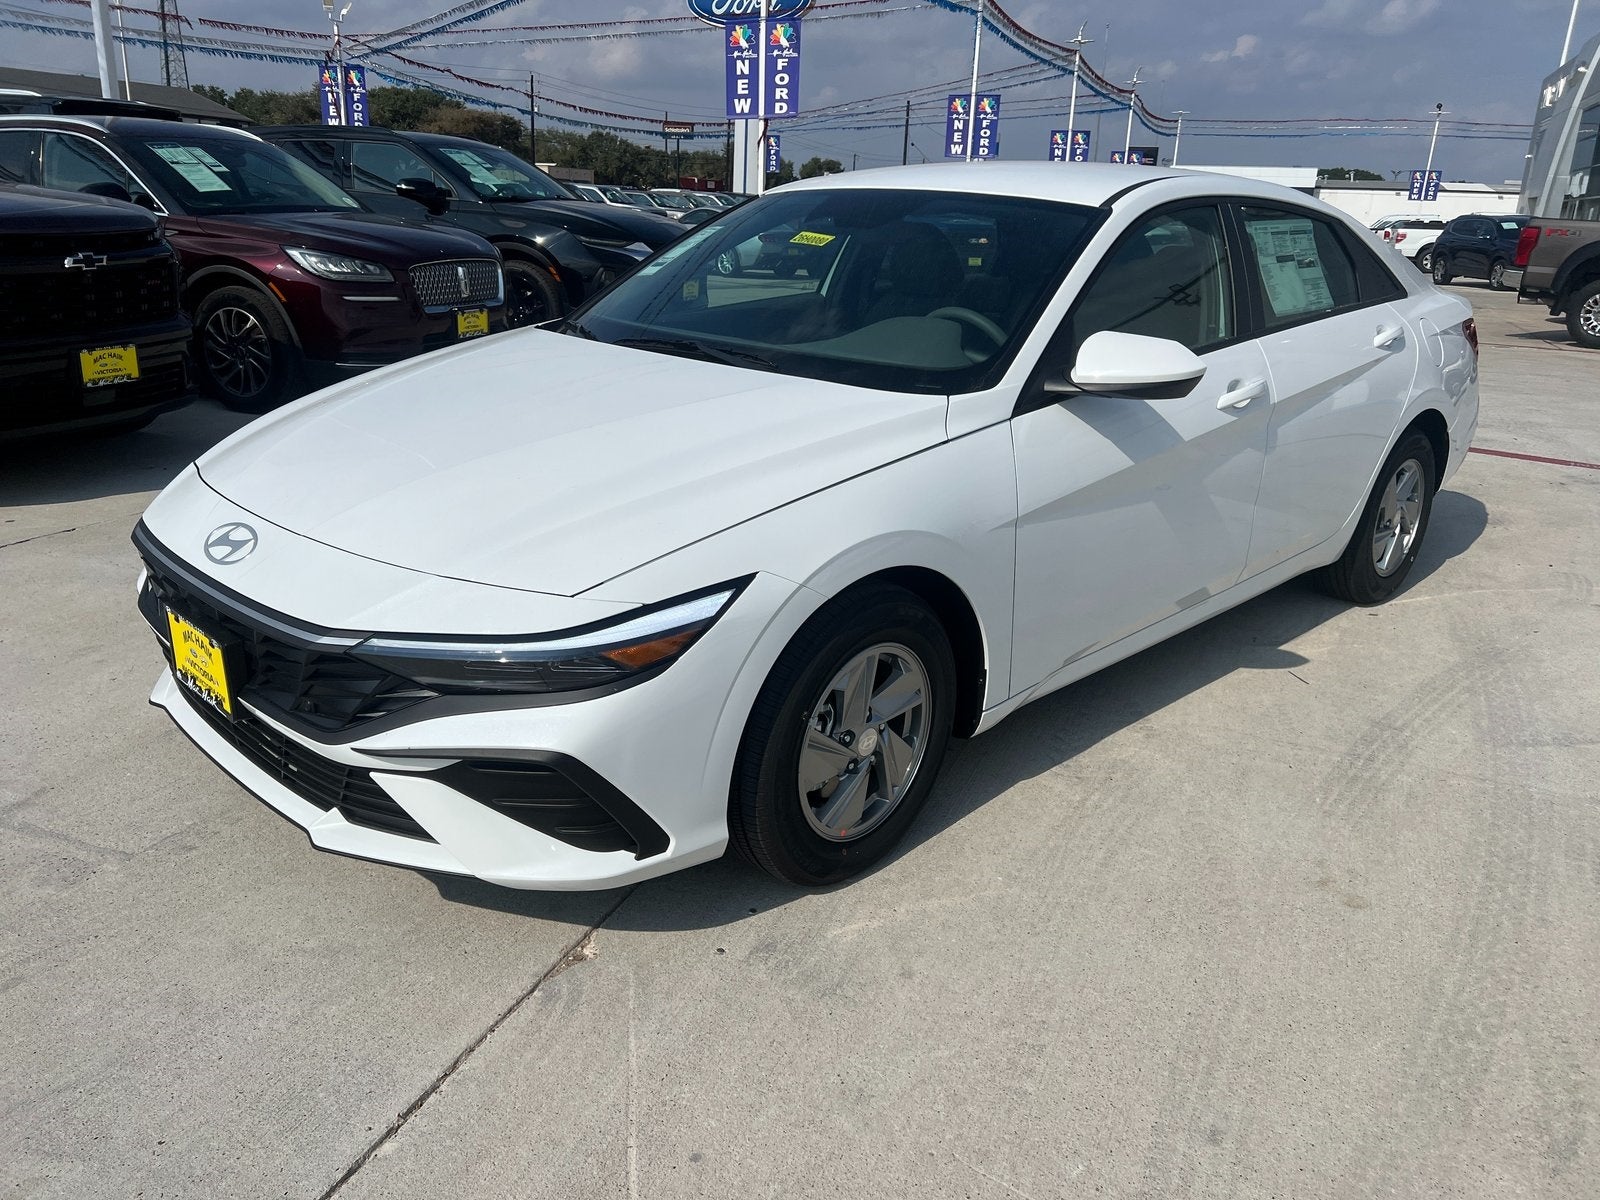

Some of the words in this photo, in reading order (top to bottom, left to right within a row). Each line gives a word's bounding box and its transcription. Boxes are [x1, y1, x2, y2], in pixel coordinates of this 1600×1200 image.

[734, 59, 751, 114] NEW
[774, 58, 789, 114] FORD
[950, 120, 963, 154] NEW
[979, 120, 990, 155] FORD
[1411, 182, 1421, 200] NEW
[1427, 182, 1436, 200] FORD
[93, 352, 107, 364] MAC
[182, 630, 195, 644] MAC
[194, 633, 214, 665] HAIK
[188, 658, 214, 682] VICTORIA
